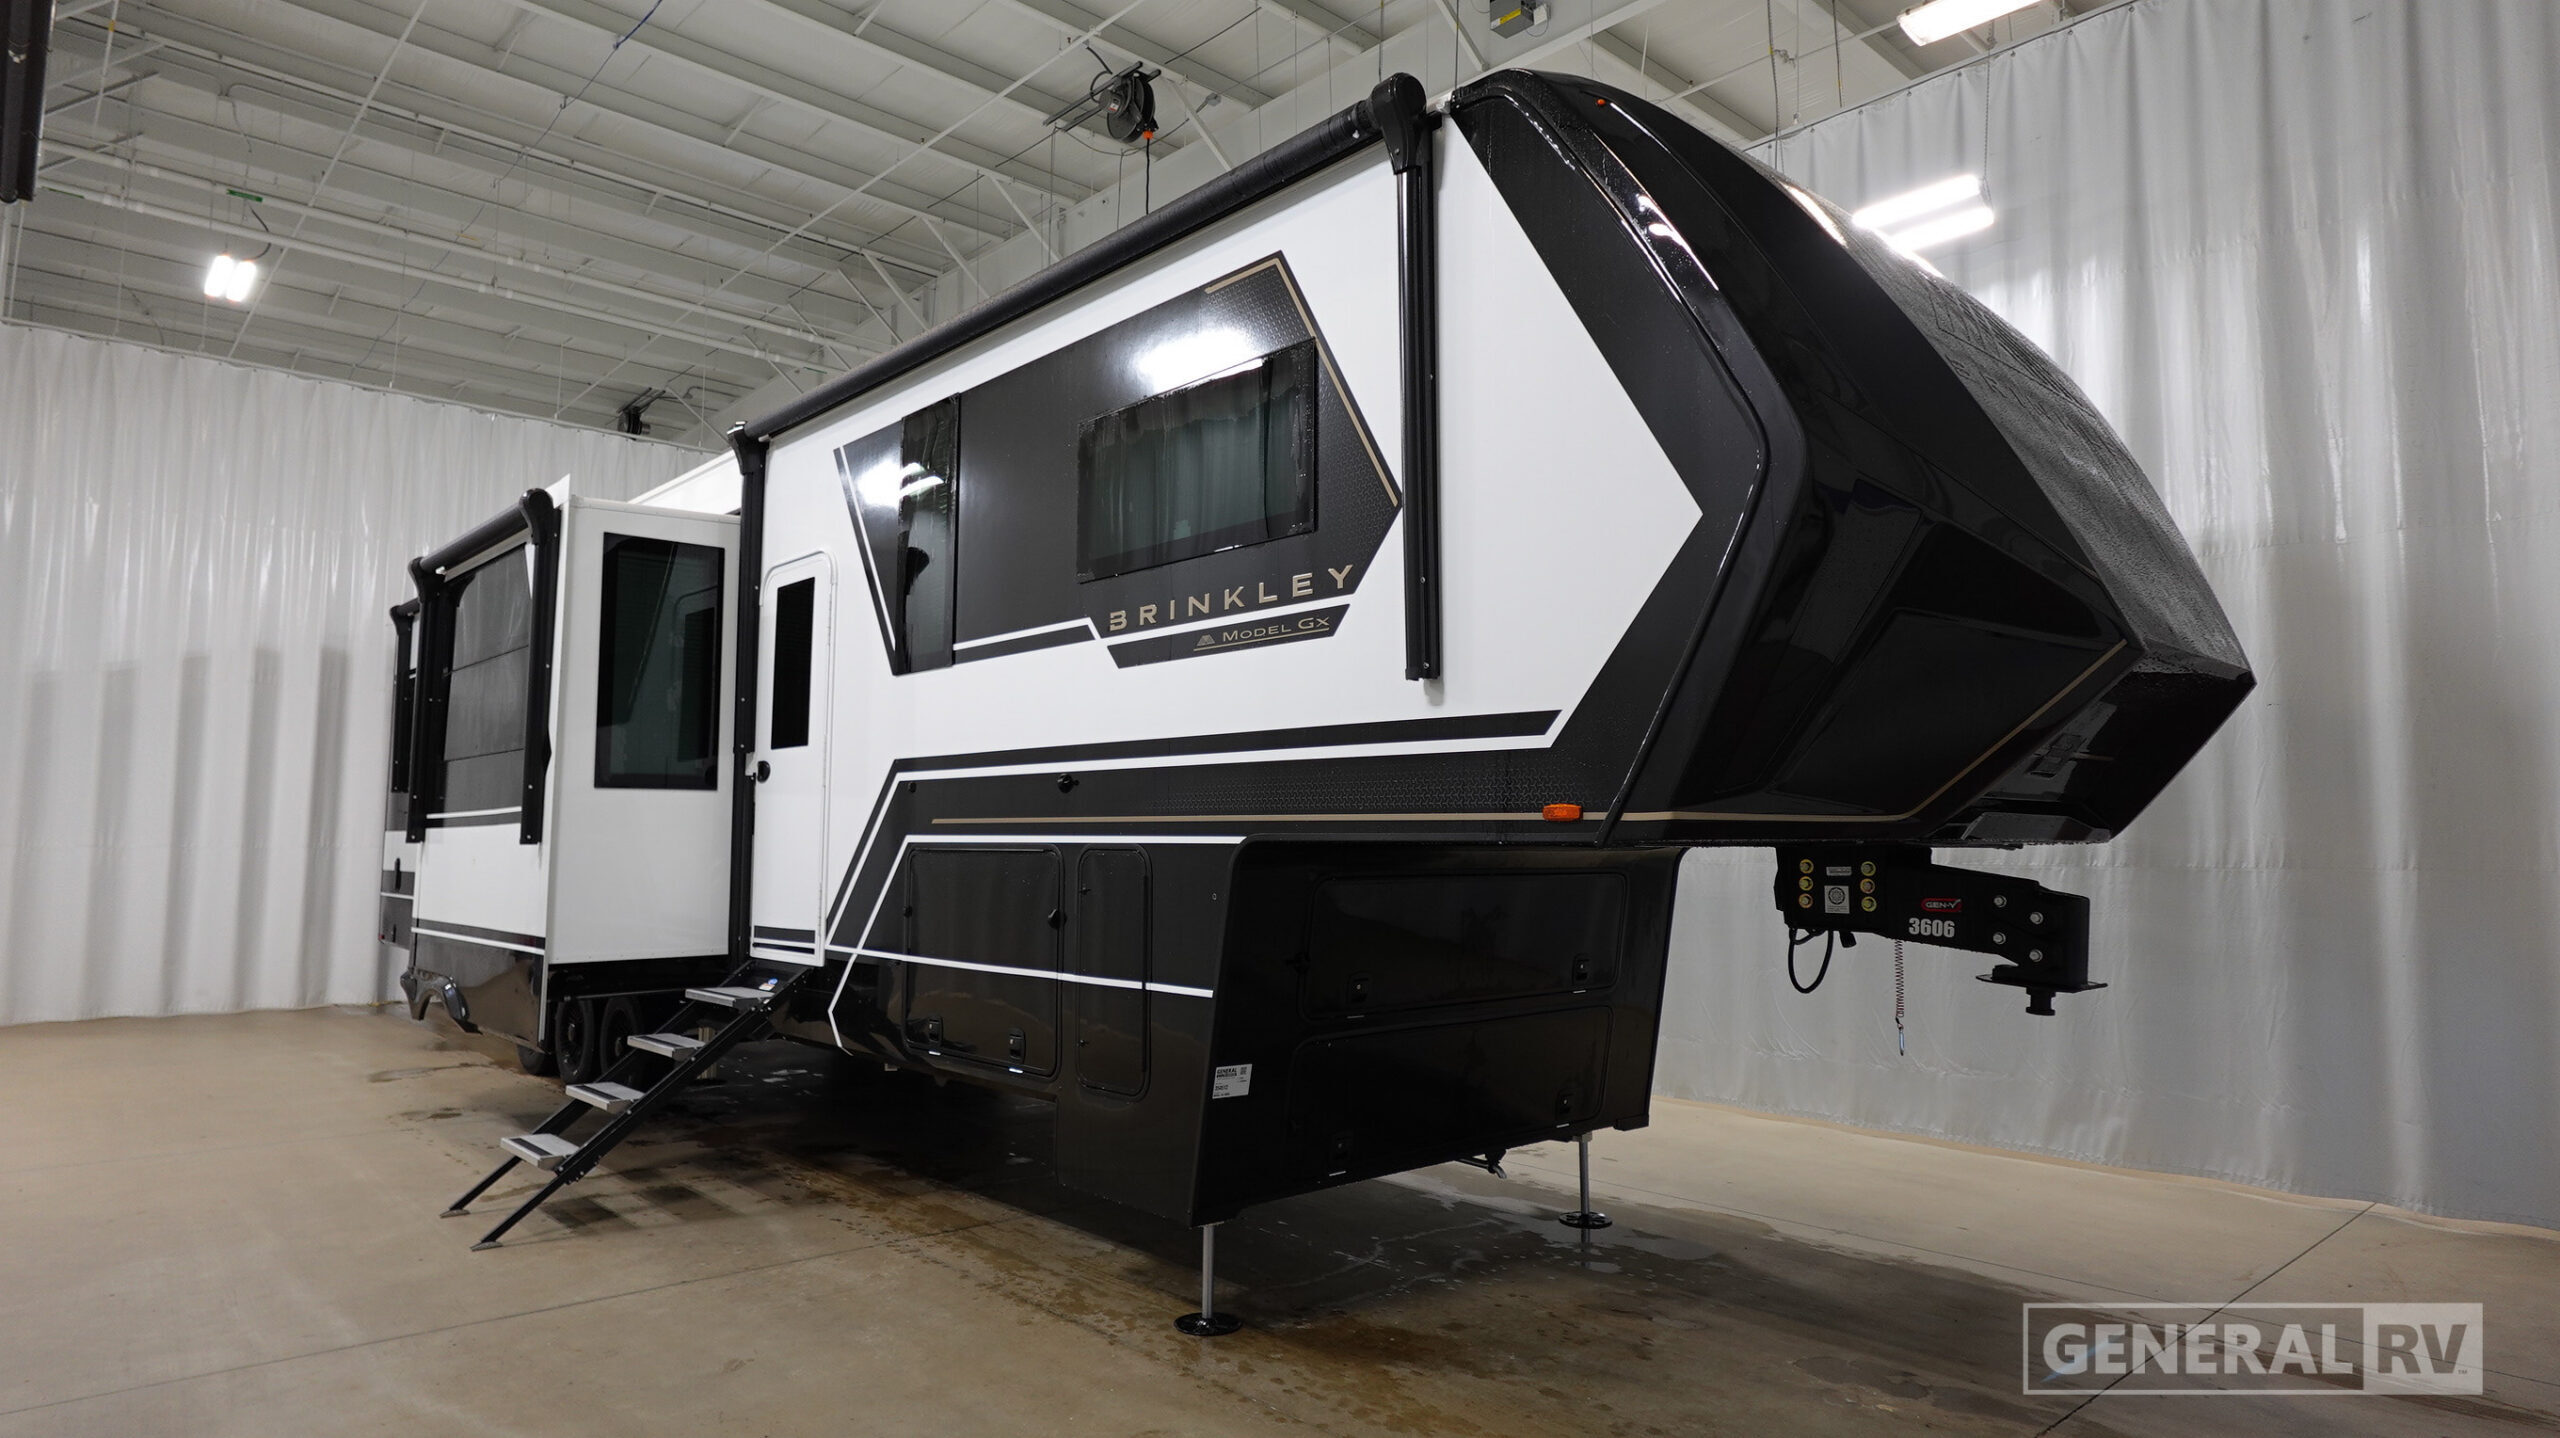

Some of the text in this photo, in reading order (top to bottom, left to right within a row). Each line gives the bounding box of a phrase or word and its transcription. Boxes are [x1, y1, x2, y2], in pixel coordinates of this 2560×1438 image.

[1109, 564, 1353, 631] BRINKLEY
[1222, 624, 1292, 642] MODEL
[1908, 917, 1955, 938] 3606
